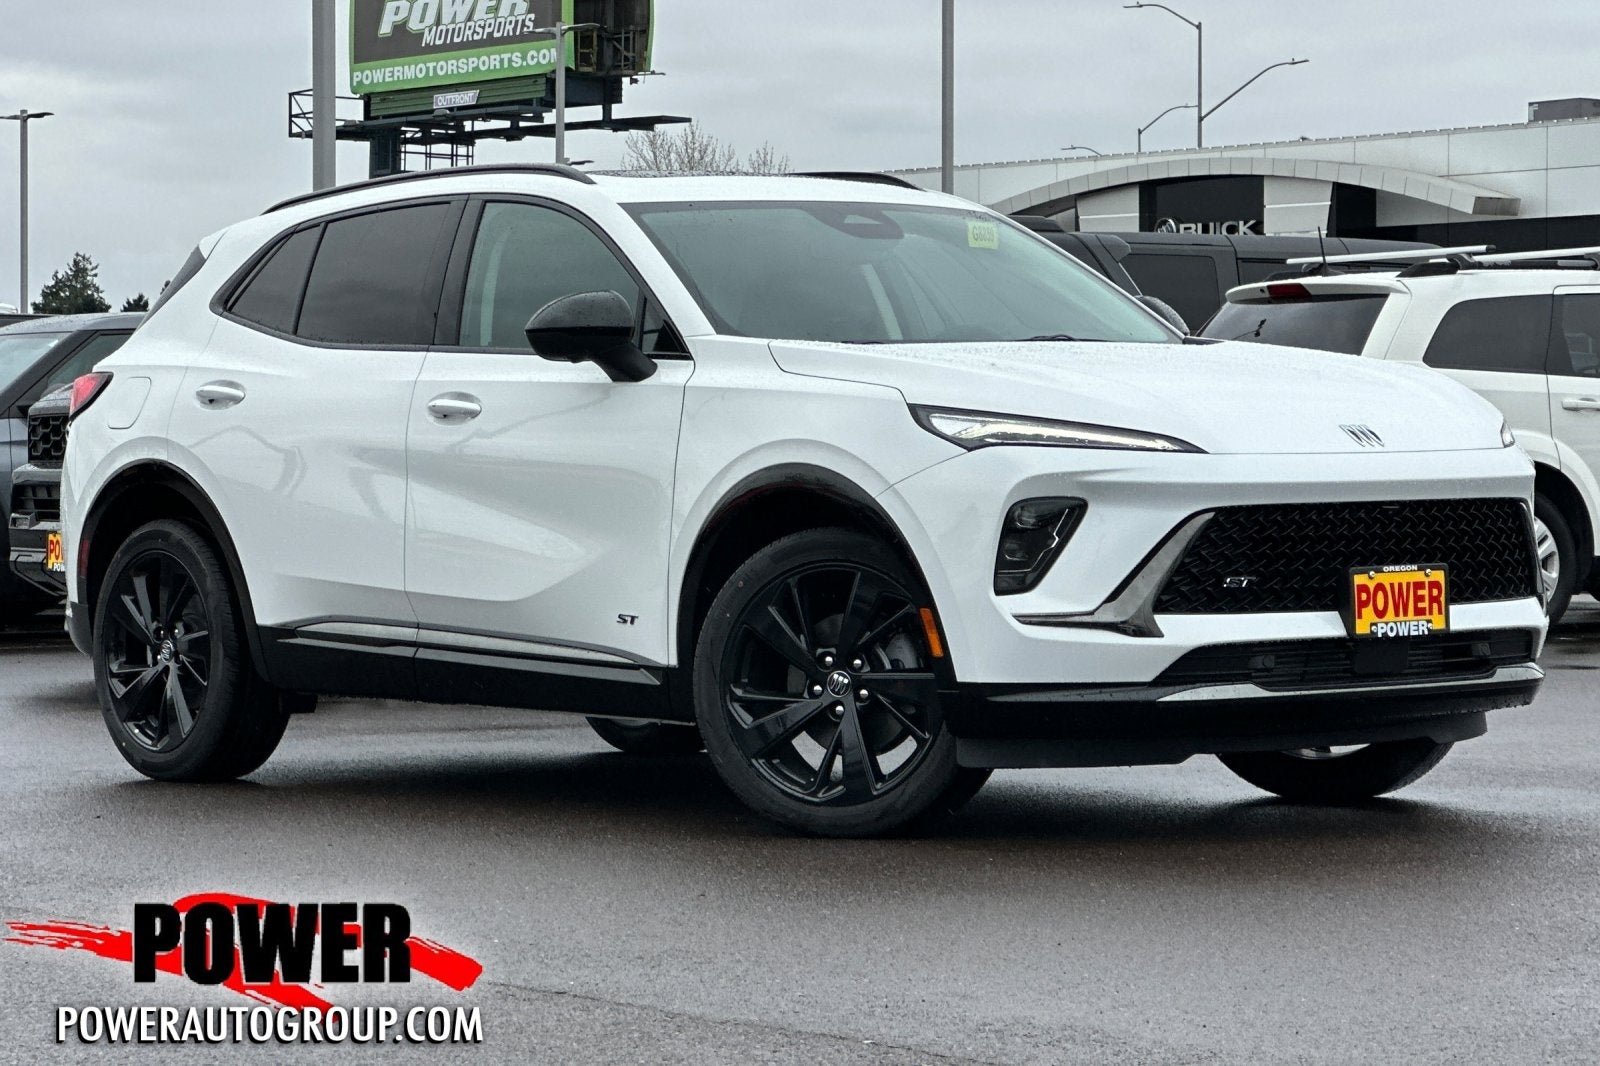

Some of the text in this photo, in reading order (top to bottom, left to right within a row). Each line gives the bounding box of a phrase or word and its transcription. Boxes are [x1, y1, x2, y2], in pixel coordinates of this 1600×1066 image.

[421, 14, 536, 47] MOTORSPORTS
[437, 92, 475, 106] OUTFRONT
[1382, 564, 1418, 573] OREGON
[1355, 580, 1443, 620] POWER
[616, 613, 640, 625] ST
[1377, 620, 1429, 638] POWER
